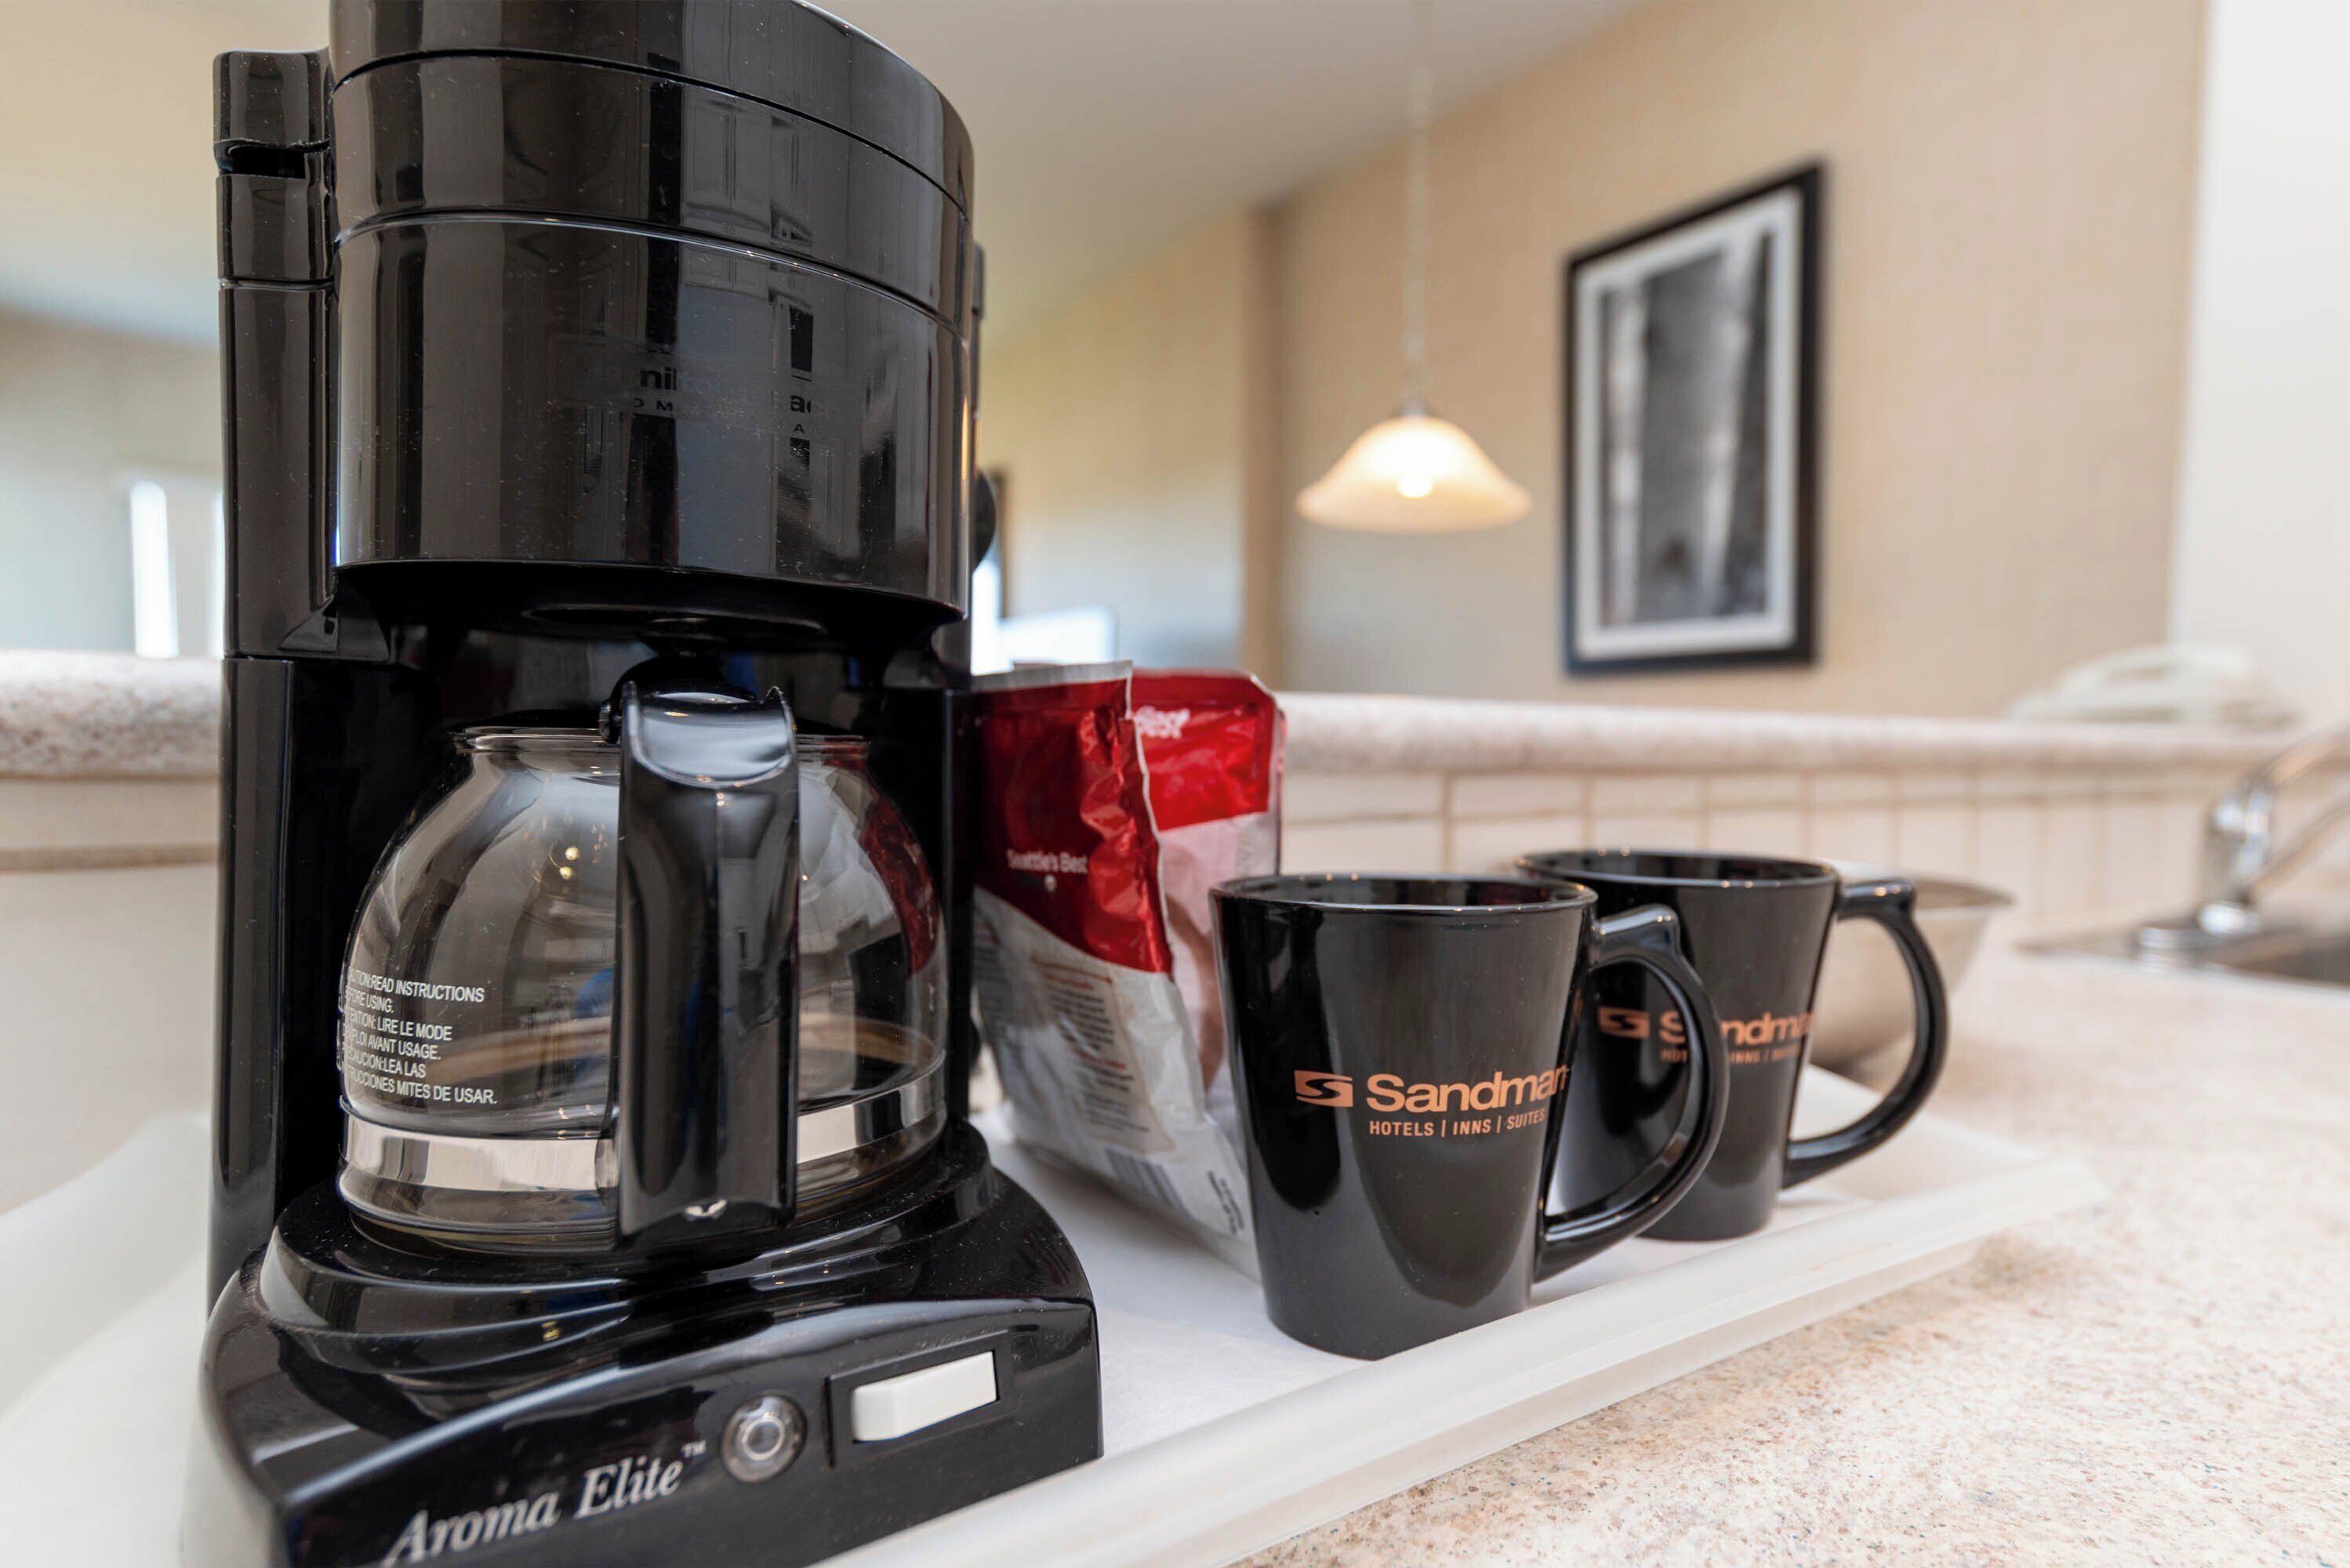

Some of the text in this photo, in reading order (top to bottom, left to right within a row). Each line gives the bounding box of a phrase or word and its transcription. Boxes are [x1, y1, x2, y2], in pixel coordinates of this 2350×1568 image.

[395, 980, 485, 1003] INSTRUCTIONS
[377, 1016, 398, 1034] LIRE
[400, 1020, 414, 1036] LE
[416, 1023, 452, 1041] MODE
[368, 1035, 397, 1054] AVANT
[398, 1040, 441, 1060] USAGE.
[405, 1061, 427, 1079] LAS
[433, 1085, 452, 1102] DE
[454, 1087, 498, 1105] USAR.
[1367, 1063, 1567, 1113] Sandman
[1369, 1108, 1546, 1137] HOTELS INNS SUITES
[379, 1492, 561, 1568] Aroma
